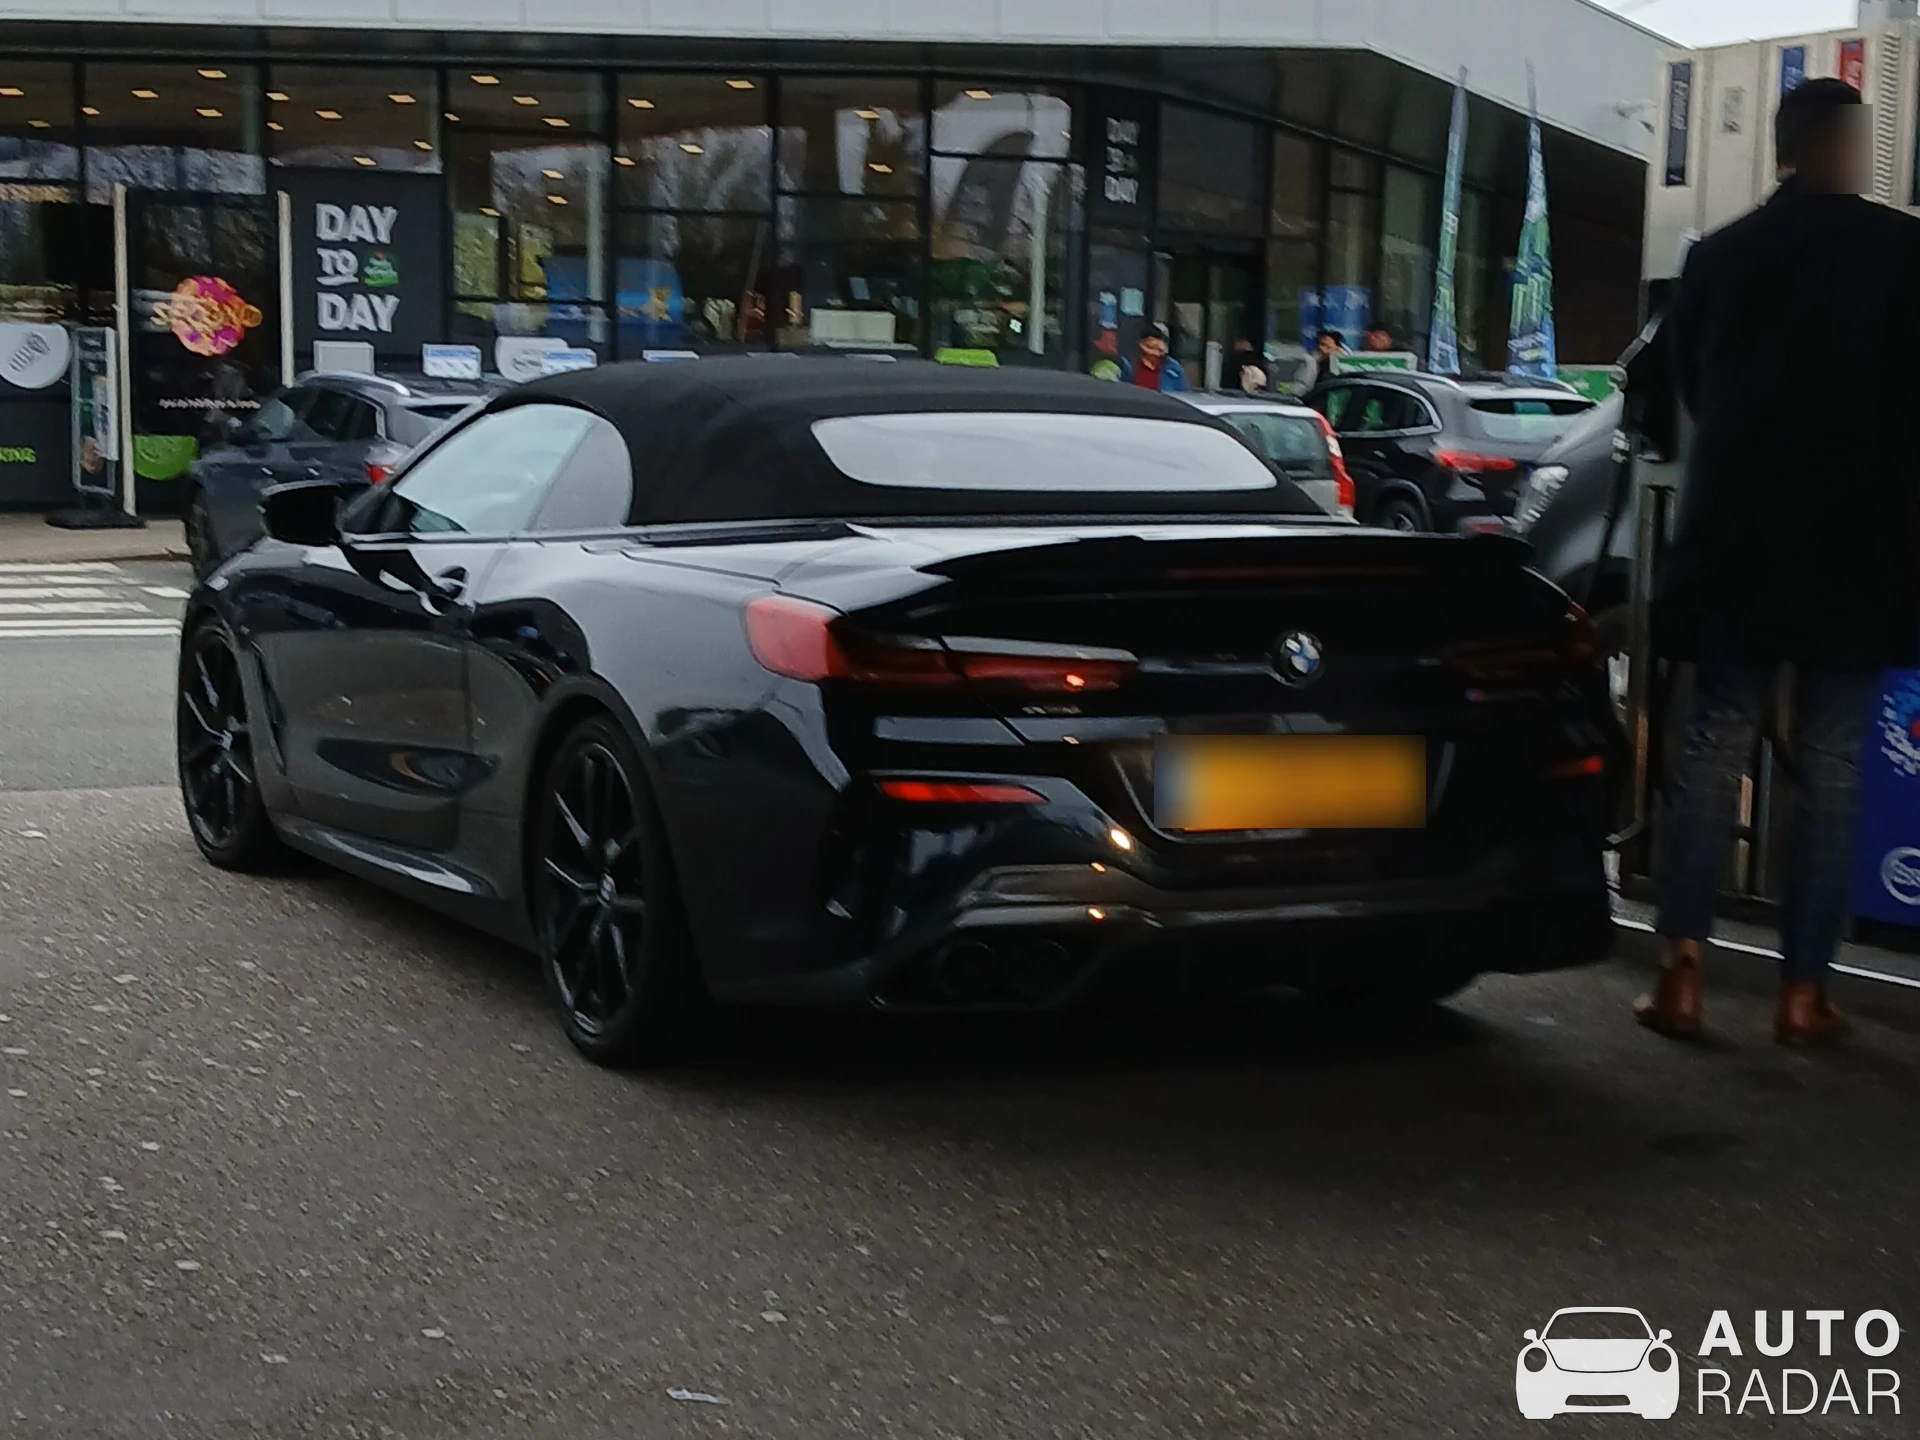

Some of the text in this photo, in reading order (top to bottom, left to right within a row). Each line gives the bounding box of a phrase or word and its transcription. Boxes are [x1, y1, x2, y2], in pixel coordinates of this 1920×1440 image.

[316, 203, 398, 244] DAY
[316, 247, 359, 286] TO
[317, 292, 400, 332] DAY
